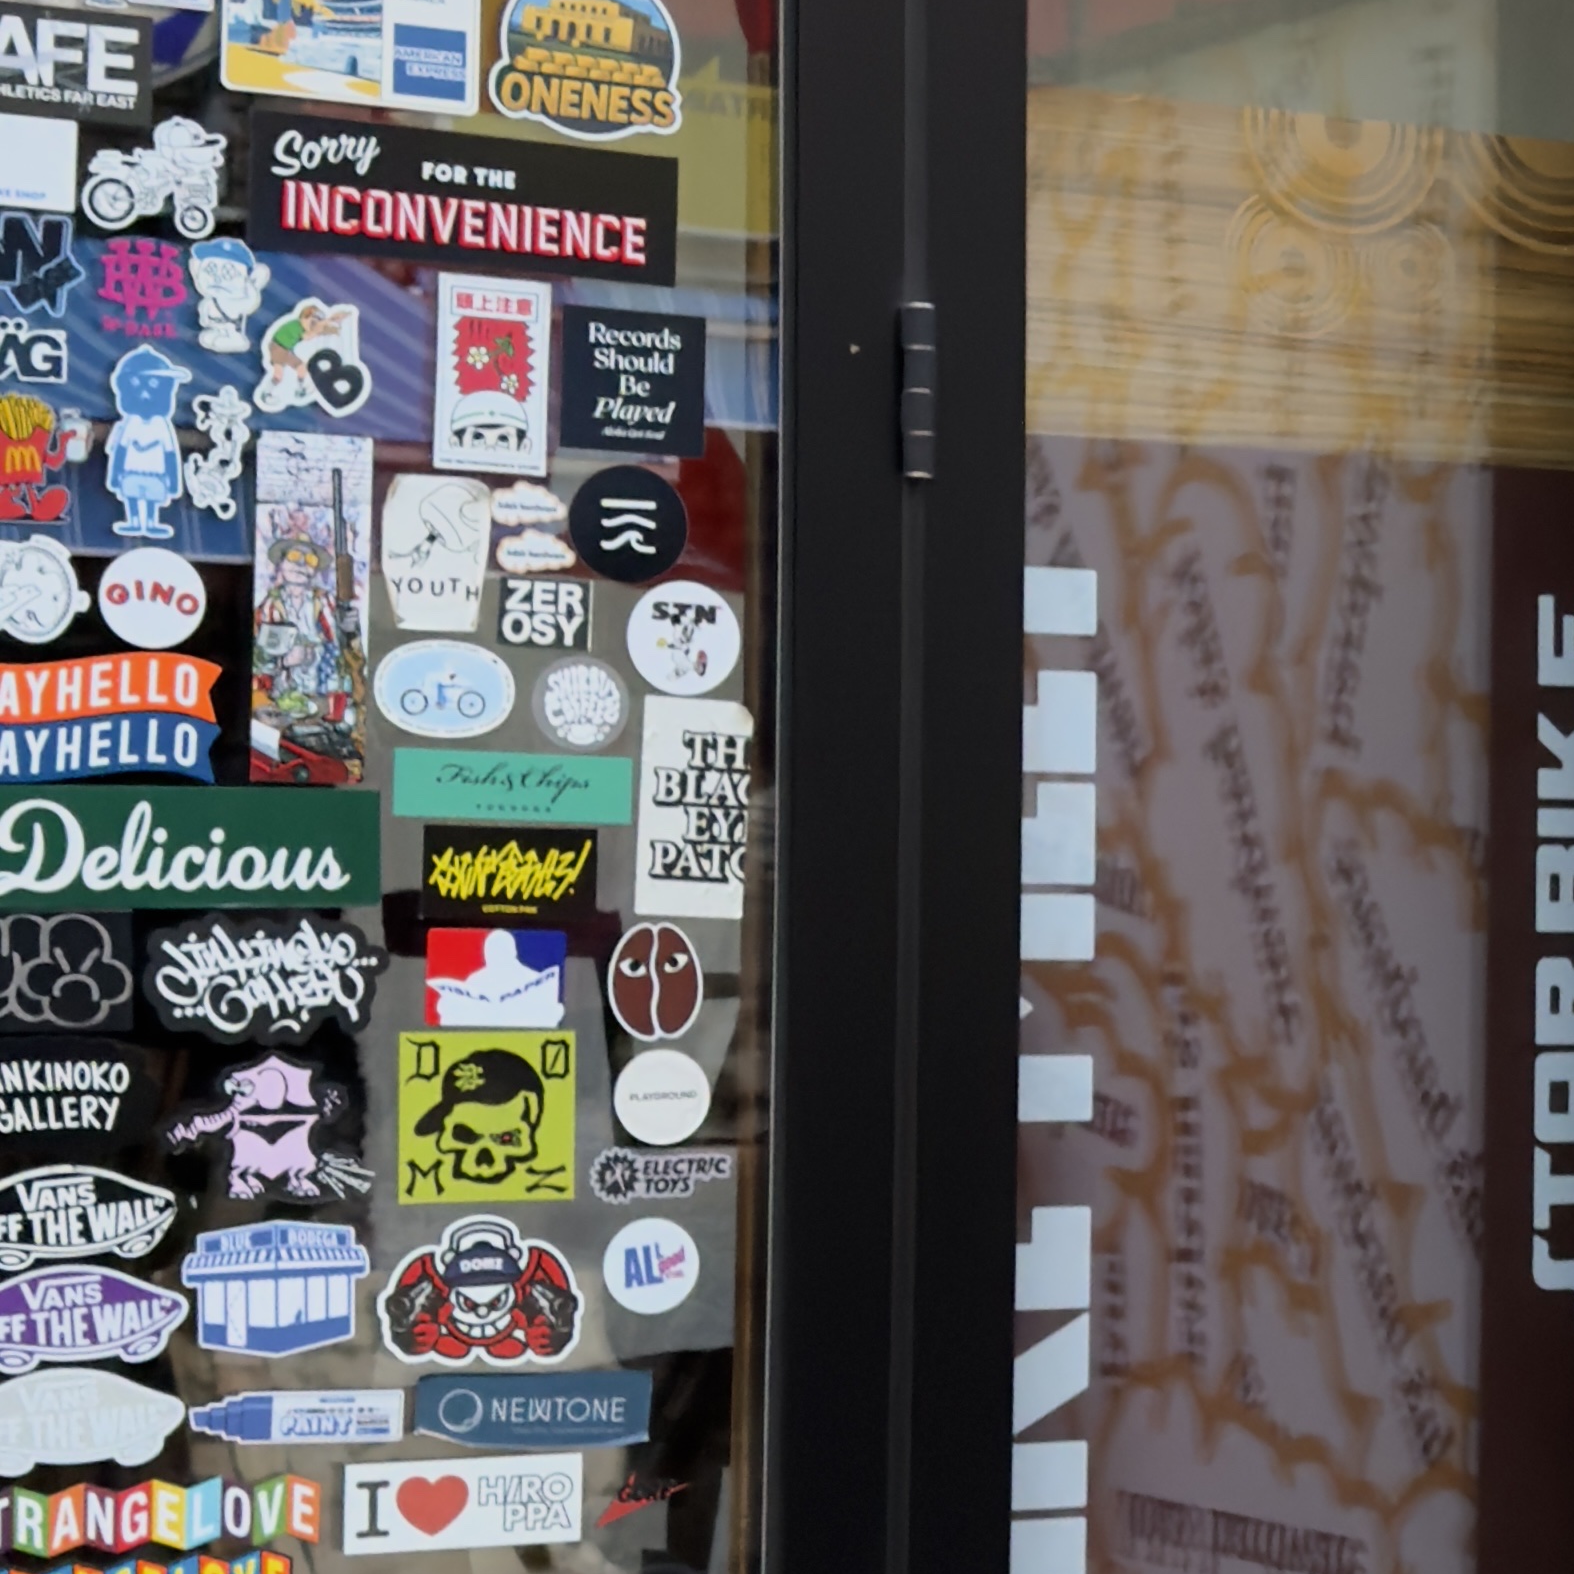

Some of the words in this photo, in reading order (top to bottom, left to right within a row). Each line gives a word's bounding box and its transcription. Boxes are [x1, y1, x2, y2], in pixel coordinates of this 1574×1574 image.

[393, 46, 463, 64] AMERICAN
[406, 62, 466, 80] EXPRESS
[64, 90, 94, 105] FAR
[97, 93, 137, 110] EAST
[500, 68, 677, 128] ONENESS
[271, 130, 380, 176] Sorry
[421, 161, 466, 186] FOR
[474, 166, 516, 190] THE
[281, 179, 647, 264] INCONVENIENCE
[589, 322, 682, 351] Records
[593, 347, 674, 375] Should
[618, 375, 651, 397] Be
[591, 396, 677, 426] Played
[390, 576, 480, 603] YOUTH
[503, 579, 585, 615] ZER
[501, 612, 585, 647] OSY
[436, 763, 501, 786] Fish
[520, 763, 591, 805] Chips
[0, 797, 351, 896] Delicious
[500, 970, 557, 1003] PAPER
[629, 1090, 698, 1102] PLAYGROUND
[642, 1155, 728, 1179] ELECTRIC
[15, 1176, 97, 1210] VANS
[643, 1176, 692, 1195] TOYS
[29, 1204, 89, 1247] THE
[220, 1231, 252, 1251] BLUE
[287, 1229, 339, 1248] BODEGA
[20, 1276, 103, 1310] VANS
[32, 1306, 91, 1348] THE
[490, 1396, 627, 1424] NEWTONE
[356, 1479, 391, 1539] I
